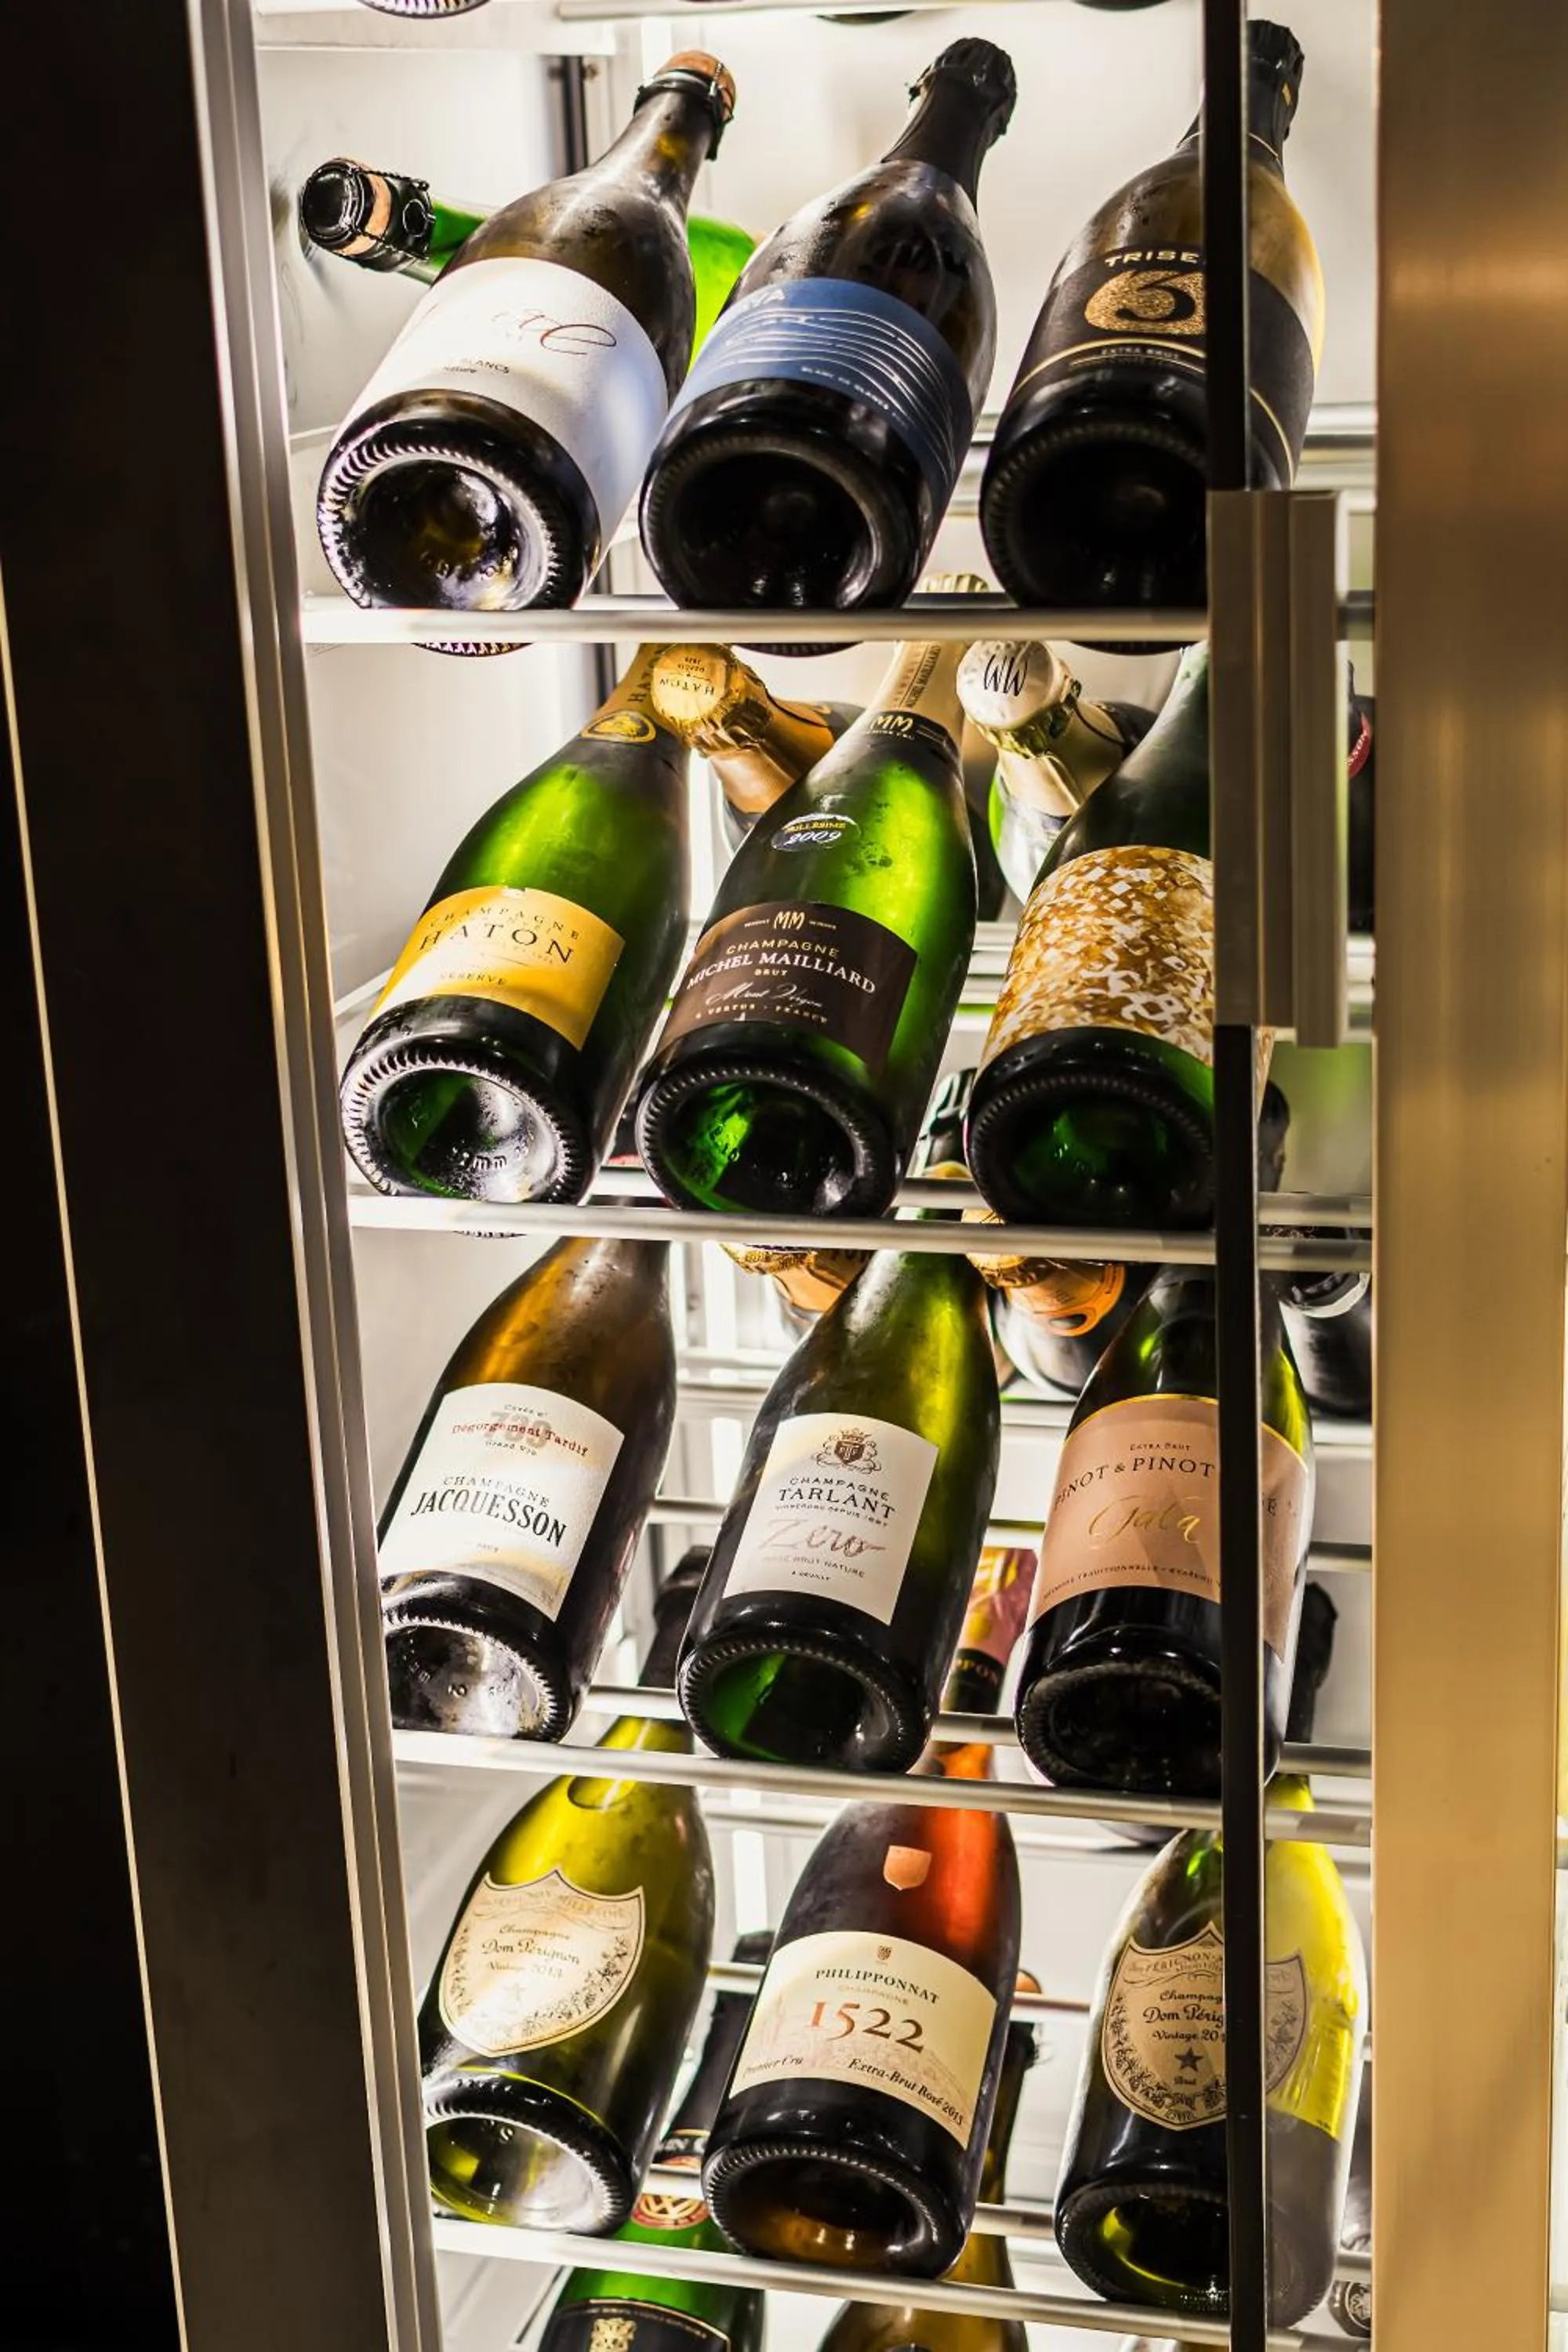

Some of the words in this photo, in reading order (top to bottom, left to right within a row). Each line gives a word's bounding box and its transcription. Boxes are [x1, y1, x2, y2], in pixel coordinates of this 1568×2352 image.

[419, 924, 575, 964] HATON
[725, 938, 840, 960] CHAMPAGNE
[686, 953, 753, 991] MICHEL
[758, 952, 877, 995] MAILLIARD
[753, 967, 789, 977] BRUT
[543, 1428, 590, 1458] Tardif
[1164, 1442, 1192, 1451] BRUT
[443, 1475, 551, 1509] CHAMPAGNE
[789, 1477, 890, 1502] CHAMPAGNE
[1054, 1464, 1110, 1511] PINOT
[1113, 1461, 1127, 1473] &
[1131, 1456, 1216, 1479] PINOT
[409, 1488, 568, 1548] JACQUESSON
[778, 1486, 895, 1519] TARLANT
[757, 1518, 887, 1558] Zero
[824, 1559, 866, 1579] NATURE
[481, 1938, 514, 1955] Dom
[815, 1968, 940, 2005] PHILIPPONNAT
[805, 2001, 925, 2054] 1522
[1142, 2006, 1180, 2024] Dom
[1152, 2029, 1197, 2042] Vintage
[781, 2054, 804, 2067] Cru
[848, 2057, 916, 2092] Extra-Brut
